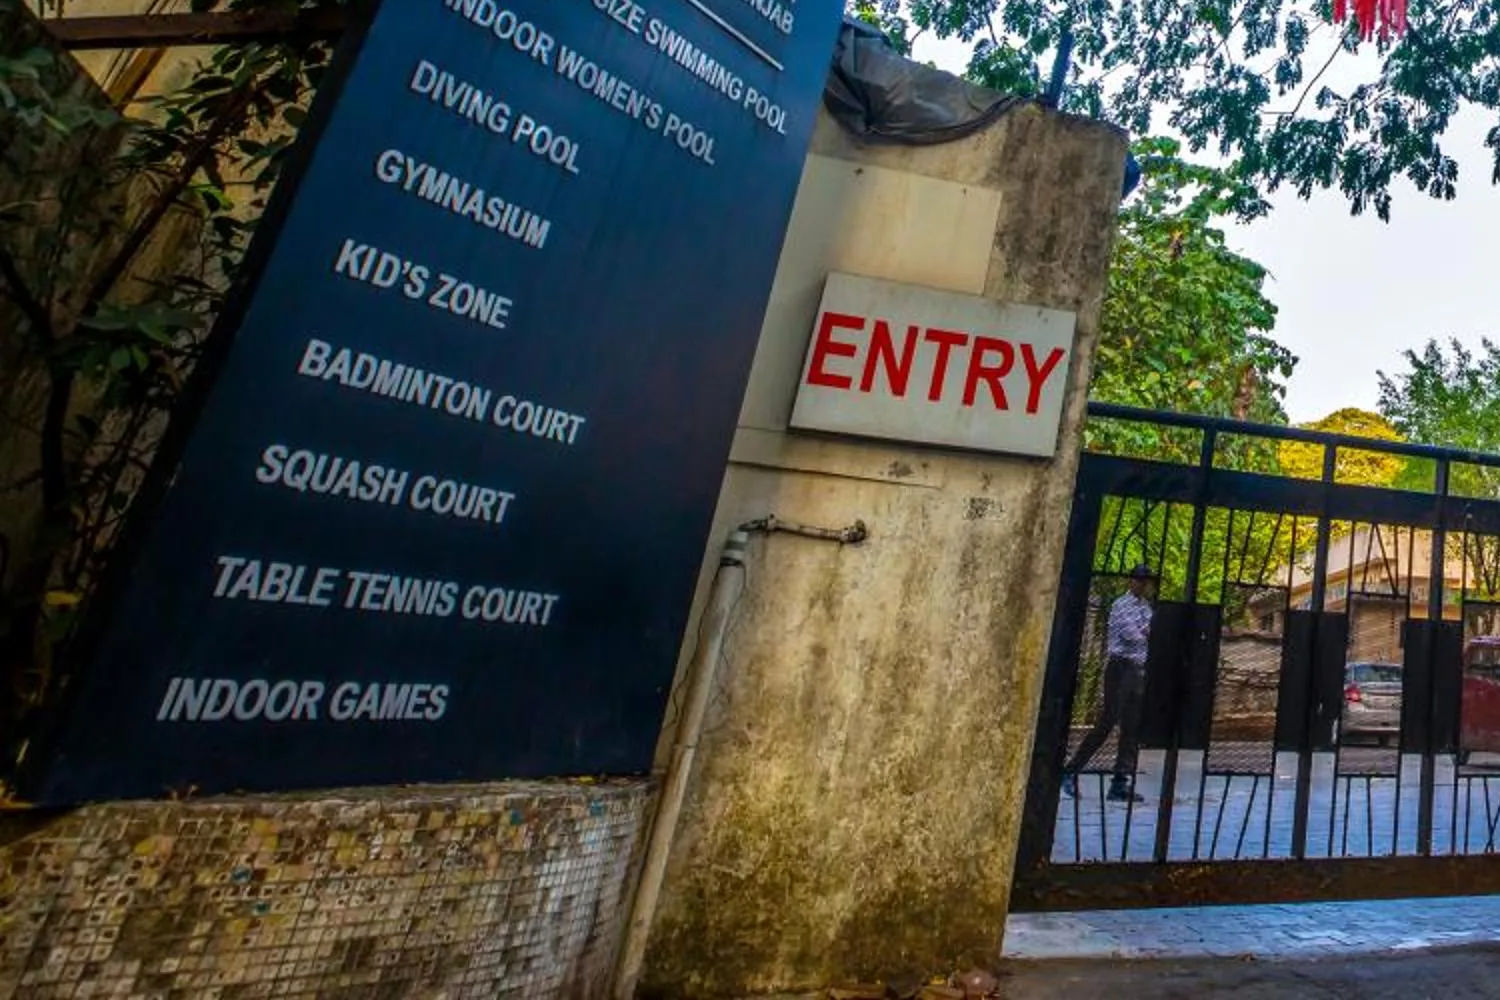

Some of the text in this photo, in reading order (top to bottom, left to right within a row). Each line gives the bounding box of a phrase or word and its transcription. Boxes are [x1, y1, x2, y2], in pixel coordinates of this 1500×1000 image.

[410, 59, 581, 175] DIVING POOL
[556, 44, 664, 130] WOMEN'S
[663, 112, 717, 167] POOL
[644, 18, 743, 101] SWIMMING
[743, 87, 788, 136] POOL
[376, 149, 551, 249] GYMNASIUM
[335, 238, 513, 329] KID'S ZONE
[298, 338, 587, 445] BADMINTON COURT
[806, 311, 1066, 415] ENTRY
[255, 443, 516, 524] SQUASH COURT
[212, 555, 560, 627] TABLE TENNIS COURT
[155, 676, 450, 722] INDOOR GAMES
